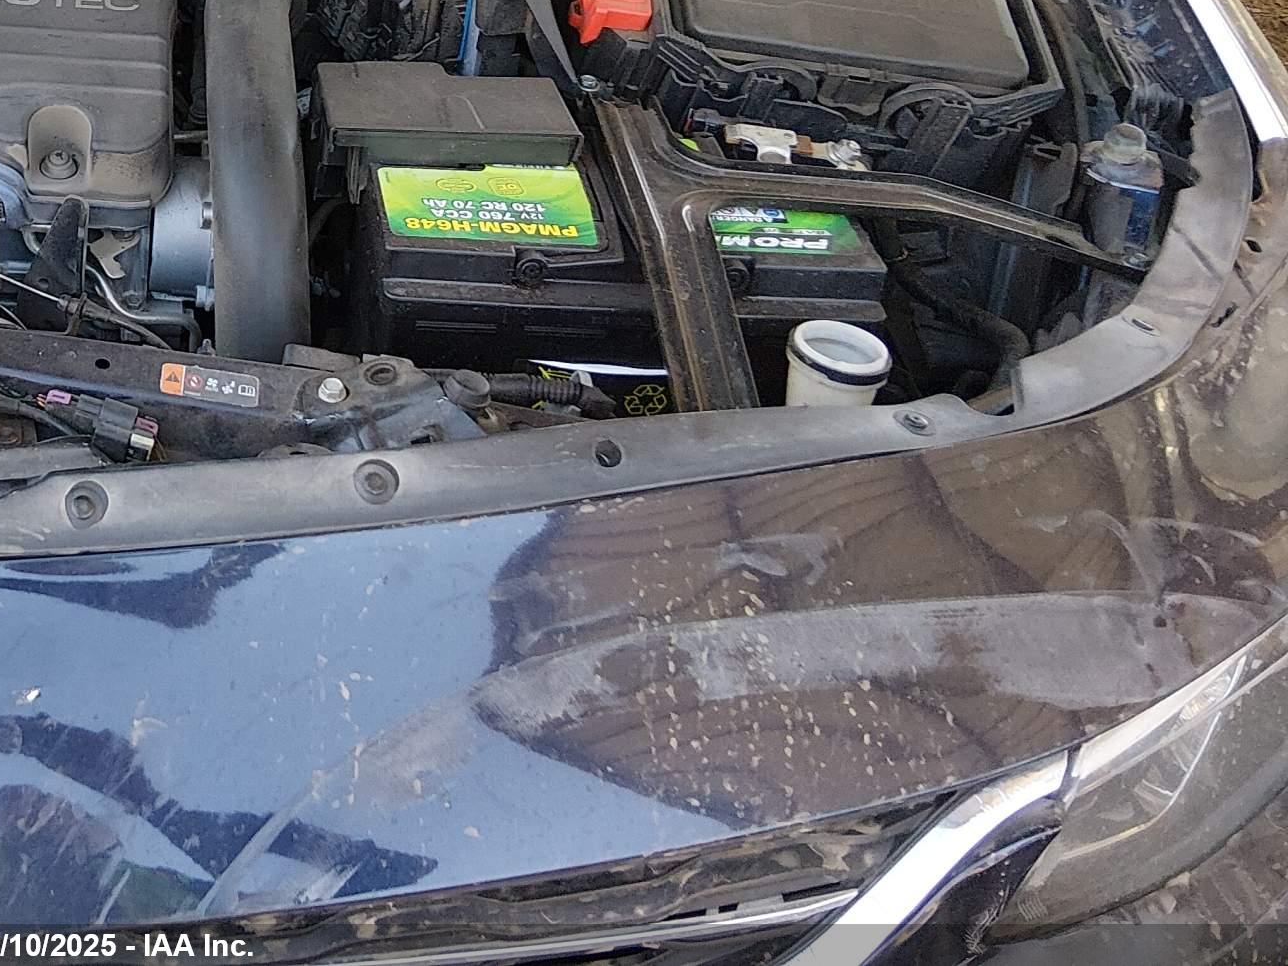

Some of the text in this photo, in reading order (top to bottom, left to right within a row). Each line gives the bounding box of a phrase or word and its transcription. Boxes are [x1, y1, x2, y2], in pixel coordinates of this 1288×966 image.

[423, 198, 546, 212] 120 RC 70 Ah
[432, 208, 473, 219] CCA
[479, 210, 515, 221] 760
[406, 218, 578, 237] PMAGM-H648
